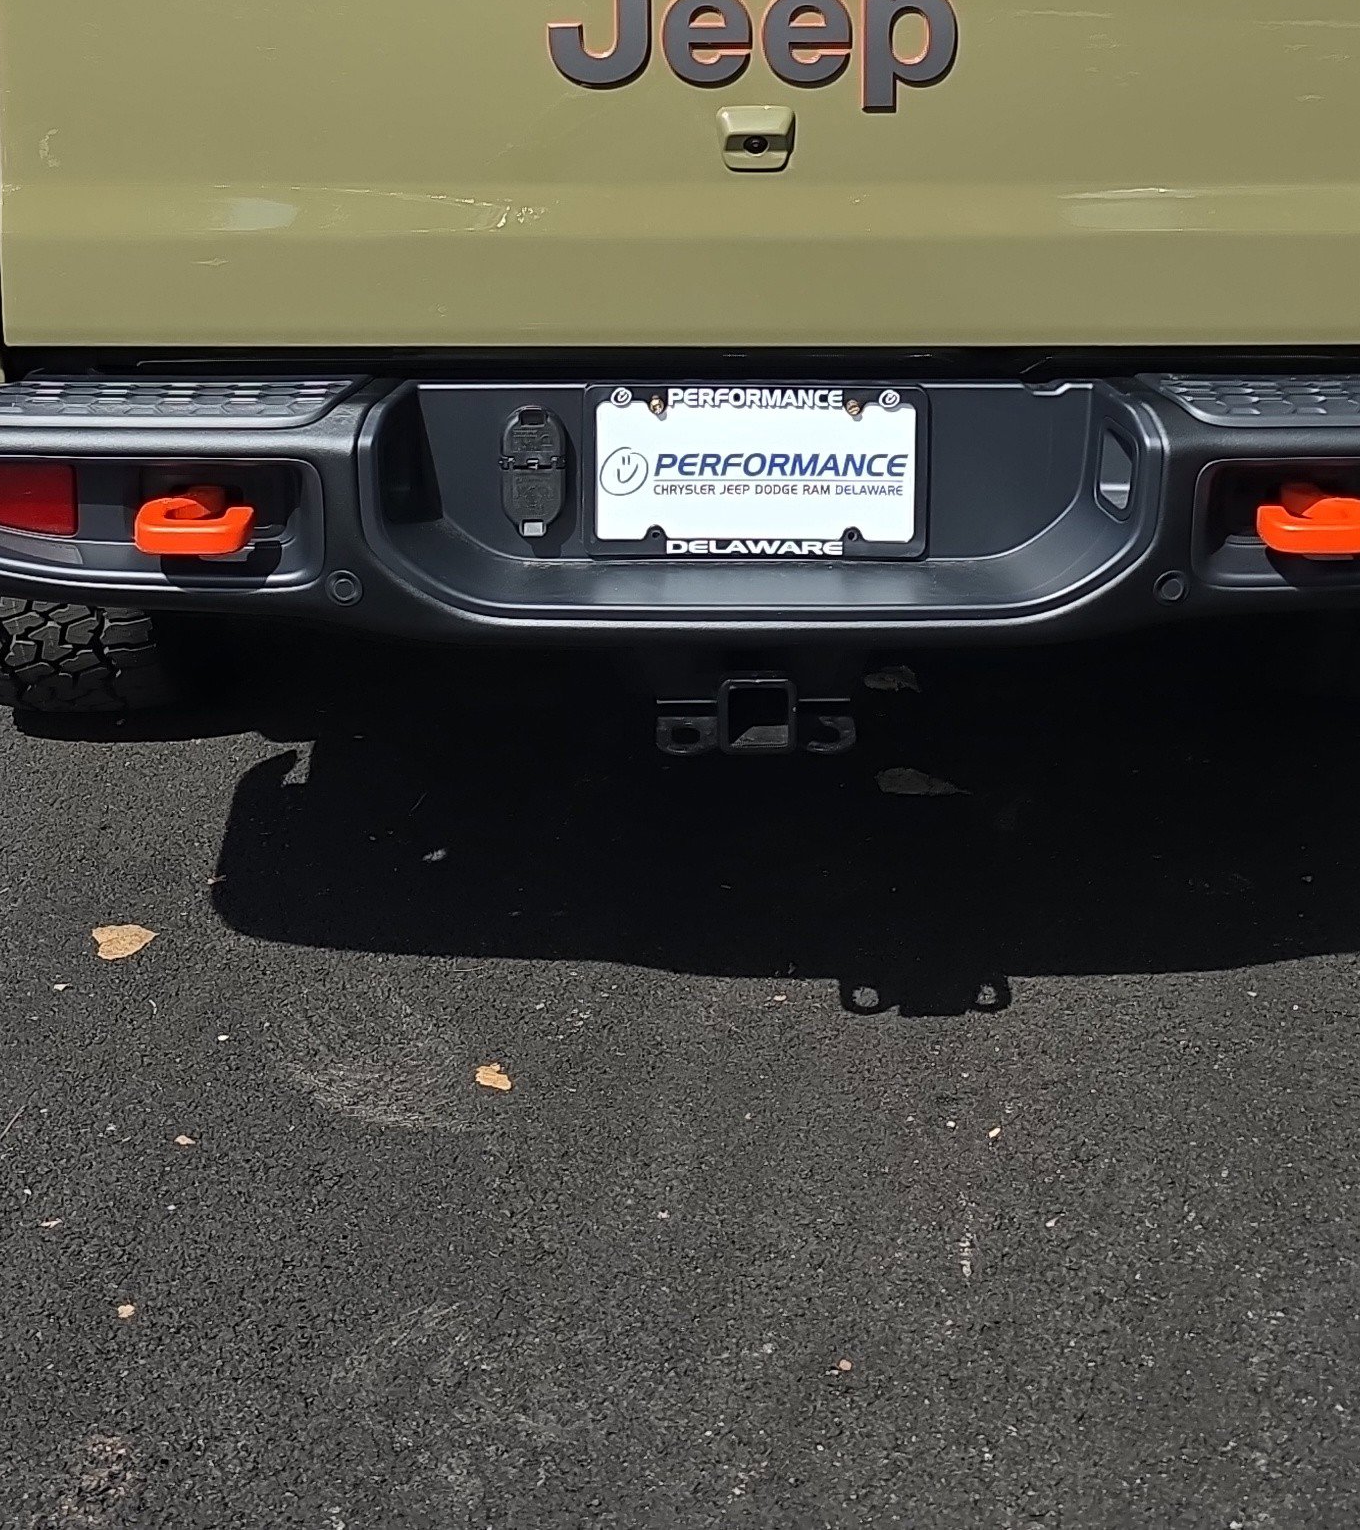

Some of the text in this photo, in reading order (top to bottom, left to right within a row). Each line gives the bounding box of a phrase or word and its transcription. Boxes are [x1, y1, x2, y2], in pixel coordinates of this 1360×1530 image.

[667, 387, 844, 410] PERFORMANCE
[653, 452, 909, 478] PERFORMANCE
[653, 483, 904, 498] CHRYSLER JEEP DODGE RAM DELAWARE
[666, 539, 844, 556] DELAWARE
